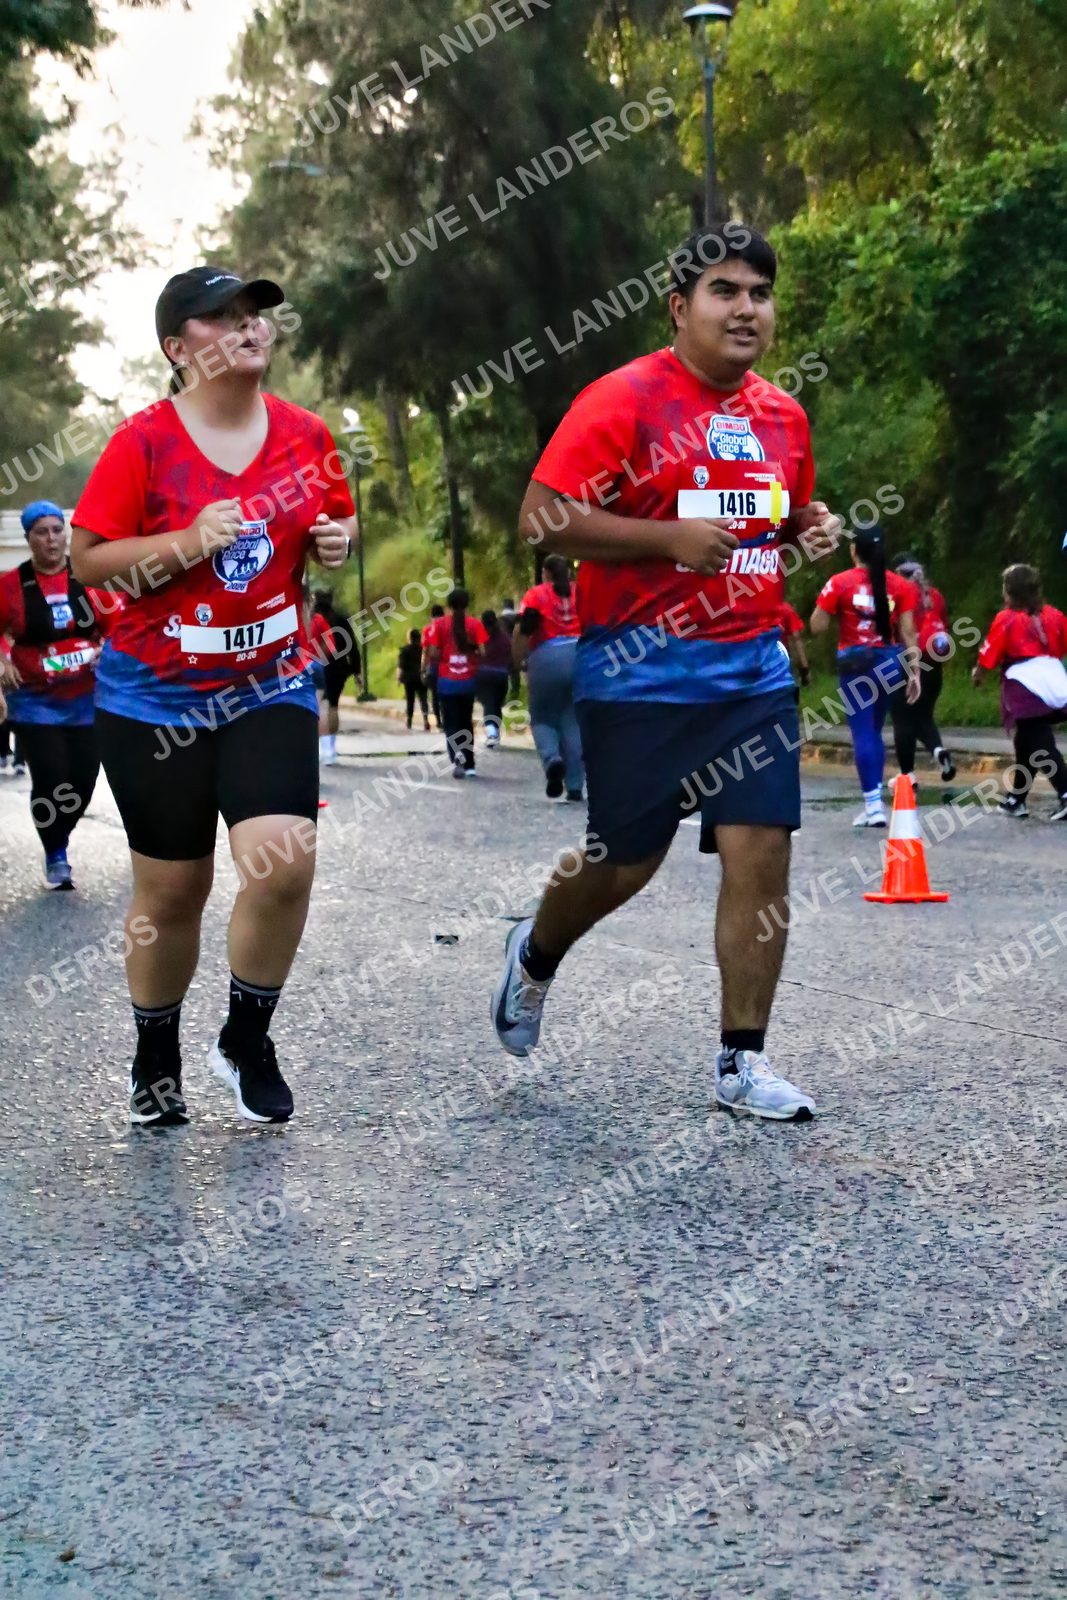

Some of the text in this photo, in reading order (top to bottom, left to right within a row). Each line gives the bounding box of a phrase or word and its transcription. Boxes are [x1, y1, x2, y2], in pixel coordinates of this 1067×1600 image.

[720, 434, 747, 446] Global
[717, 442, 739, 453] Race
[718, 492, 756, 516] 1416
[222, 550, 246, 560] Race
[223, 622, 265, 650] 1417
